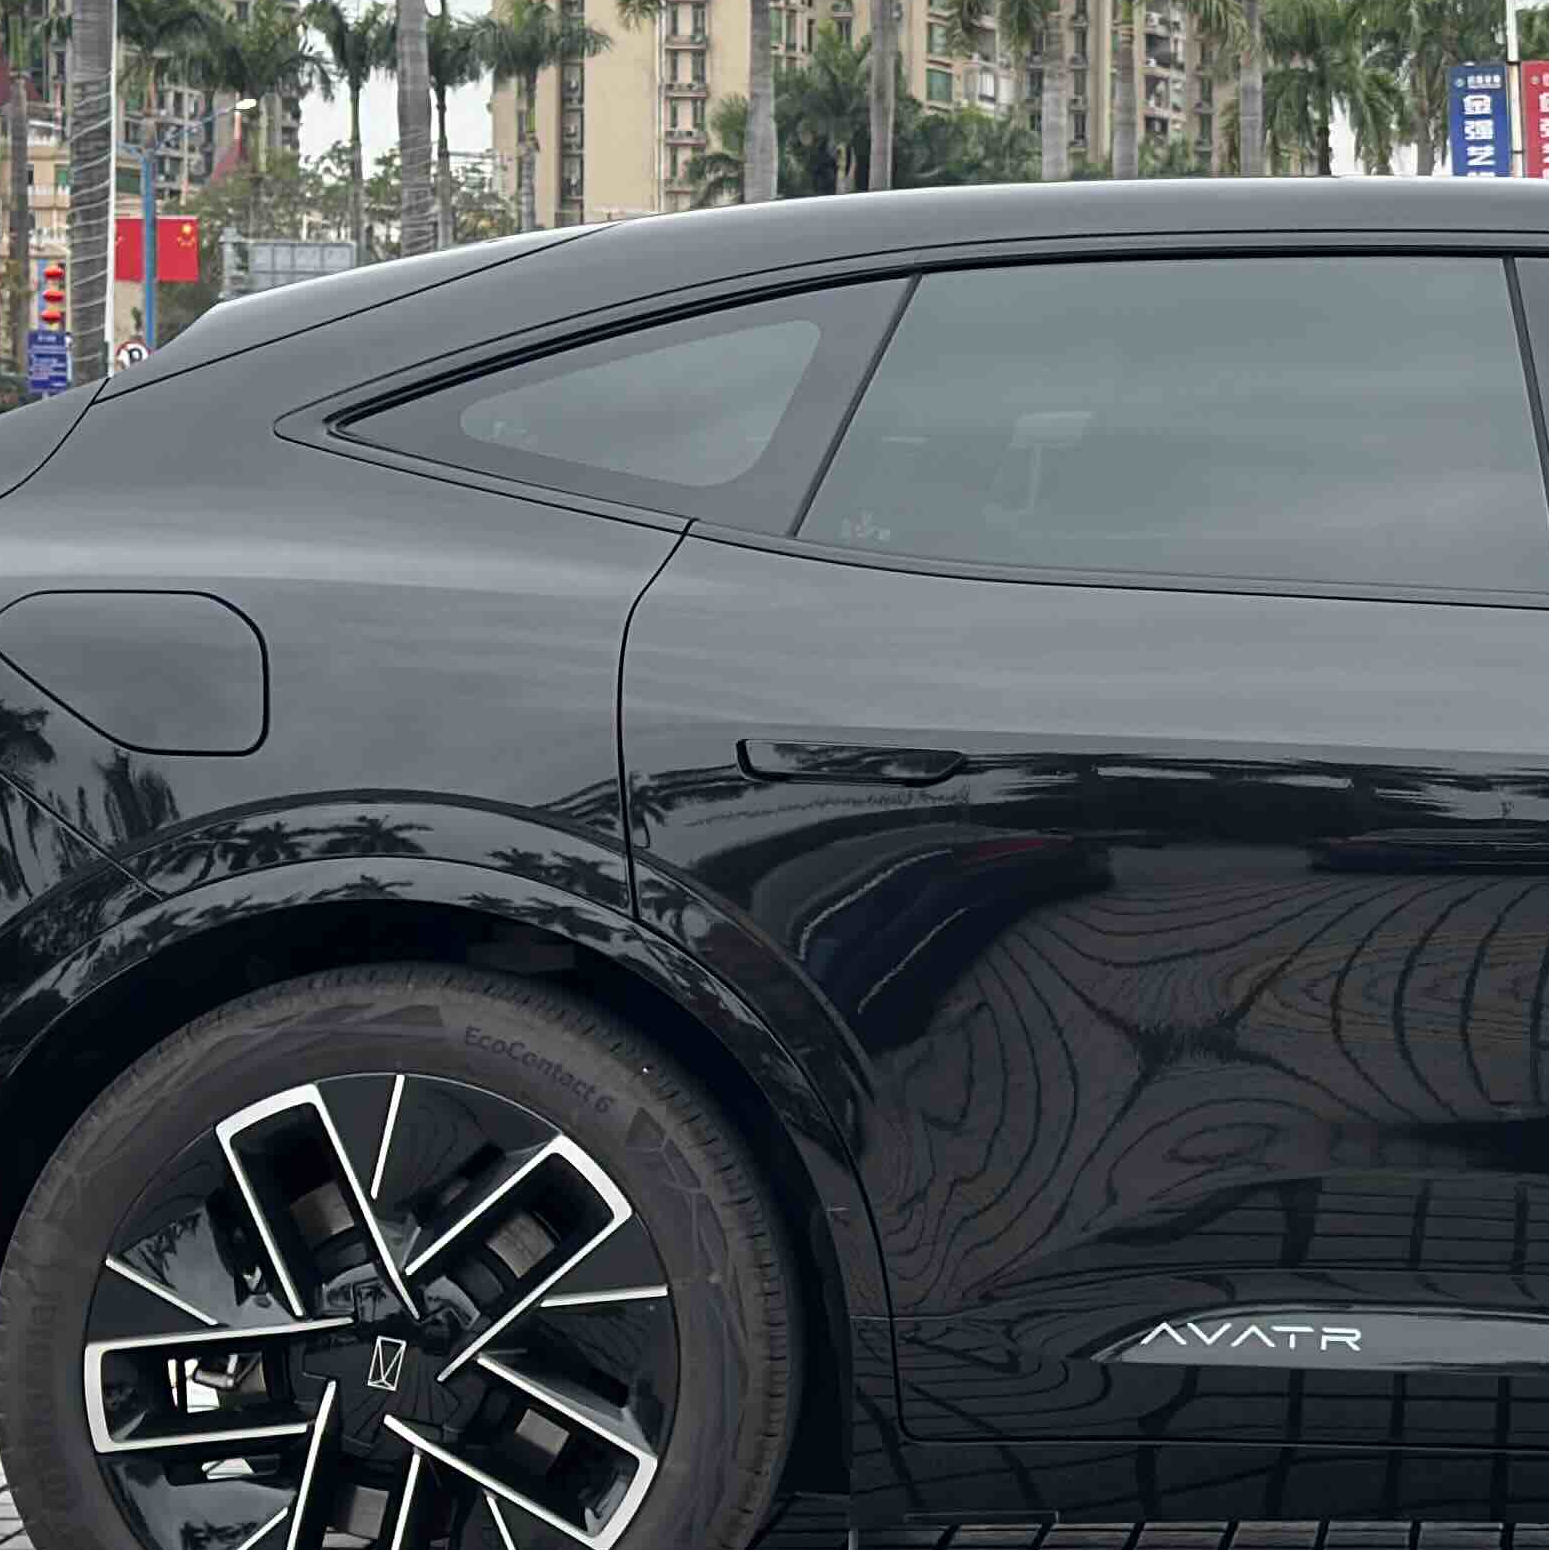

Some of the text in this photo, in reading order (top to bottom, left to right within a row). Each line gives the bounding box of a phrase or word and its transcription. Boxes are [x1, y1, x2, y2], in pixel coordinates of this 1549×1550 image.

[464, 1026, 613, 1114] EcoContact 6
[1140, 1321, 1362, 1351] AVATR
